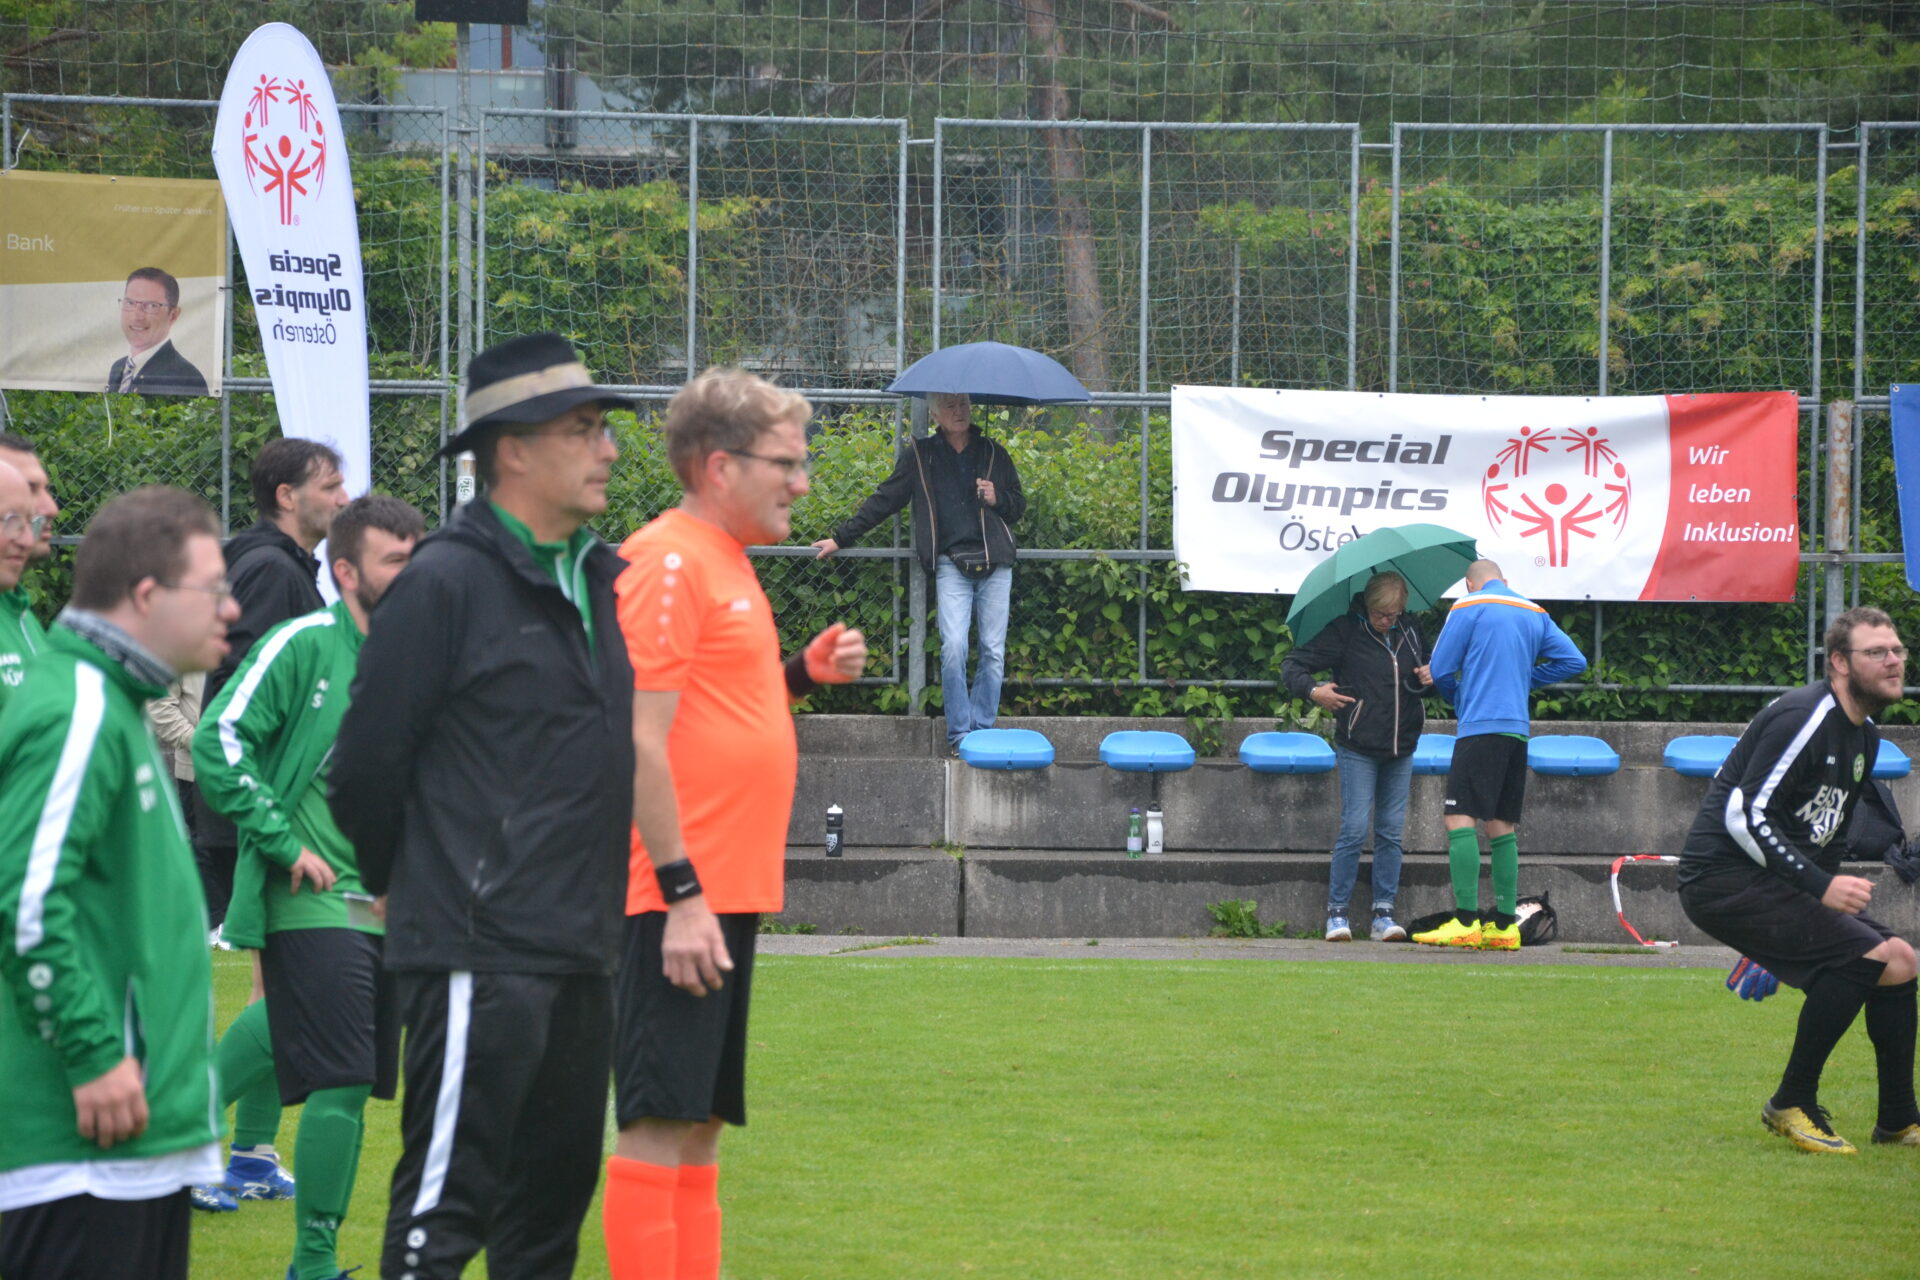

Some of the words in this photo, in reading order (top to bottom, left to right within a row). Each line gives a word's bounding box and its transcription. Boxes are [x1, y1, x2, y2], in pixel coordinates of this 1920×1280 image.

[7, 233, 55, 252] Bank
[1259, 429, 1452, 469] Special
[1688, 445, 1729, 465] Wir
[1211, 471, 1449, 516] Olympics
[1688, 483, 1751, 503] leben
[1683, 522, 1795, 543] Inklusion!
